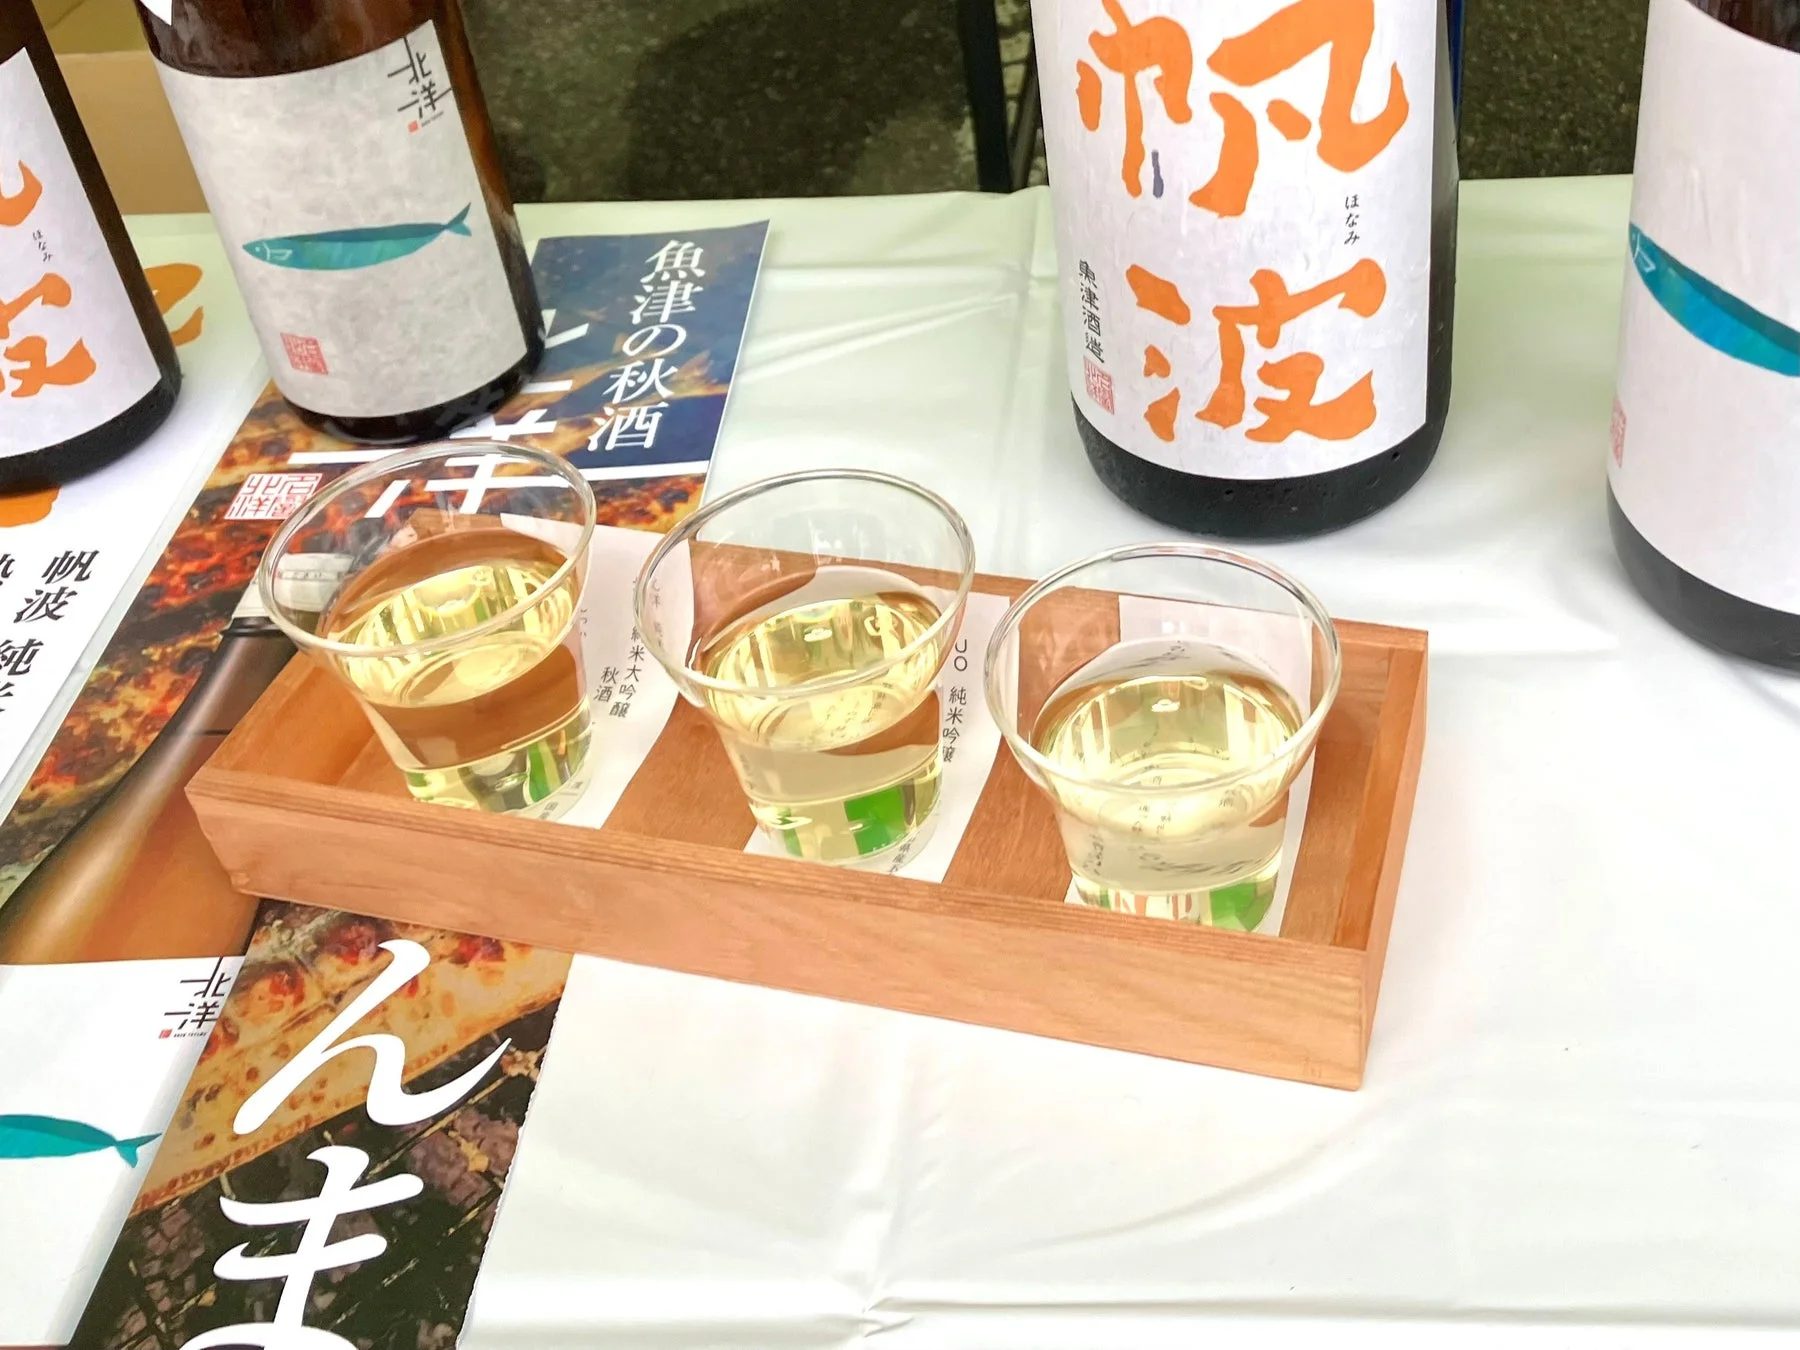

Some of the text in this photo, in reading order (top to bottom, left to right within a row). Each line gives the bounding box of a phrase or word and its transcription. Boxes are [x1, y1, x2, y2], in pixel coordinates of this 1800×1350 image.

[387, 37, 452, 119] 北洋
[1075, 0, 1409, 443] 帆波
[1344, 194, 1360, 246] ほなみ
[588, 240, 706, 452] 魚津の秋酒
[1079, 259, 1104, 364] 魚津酒造
[13, 550, 99, 623] 帆波
[593, 666, 620, 702] 秋酒
[164, 956, 231, 1030] 北洋
